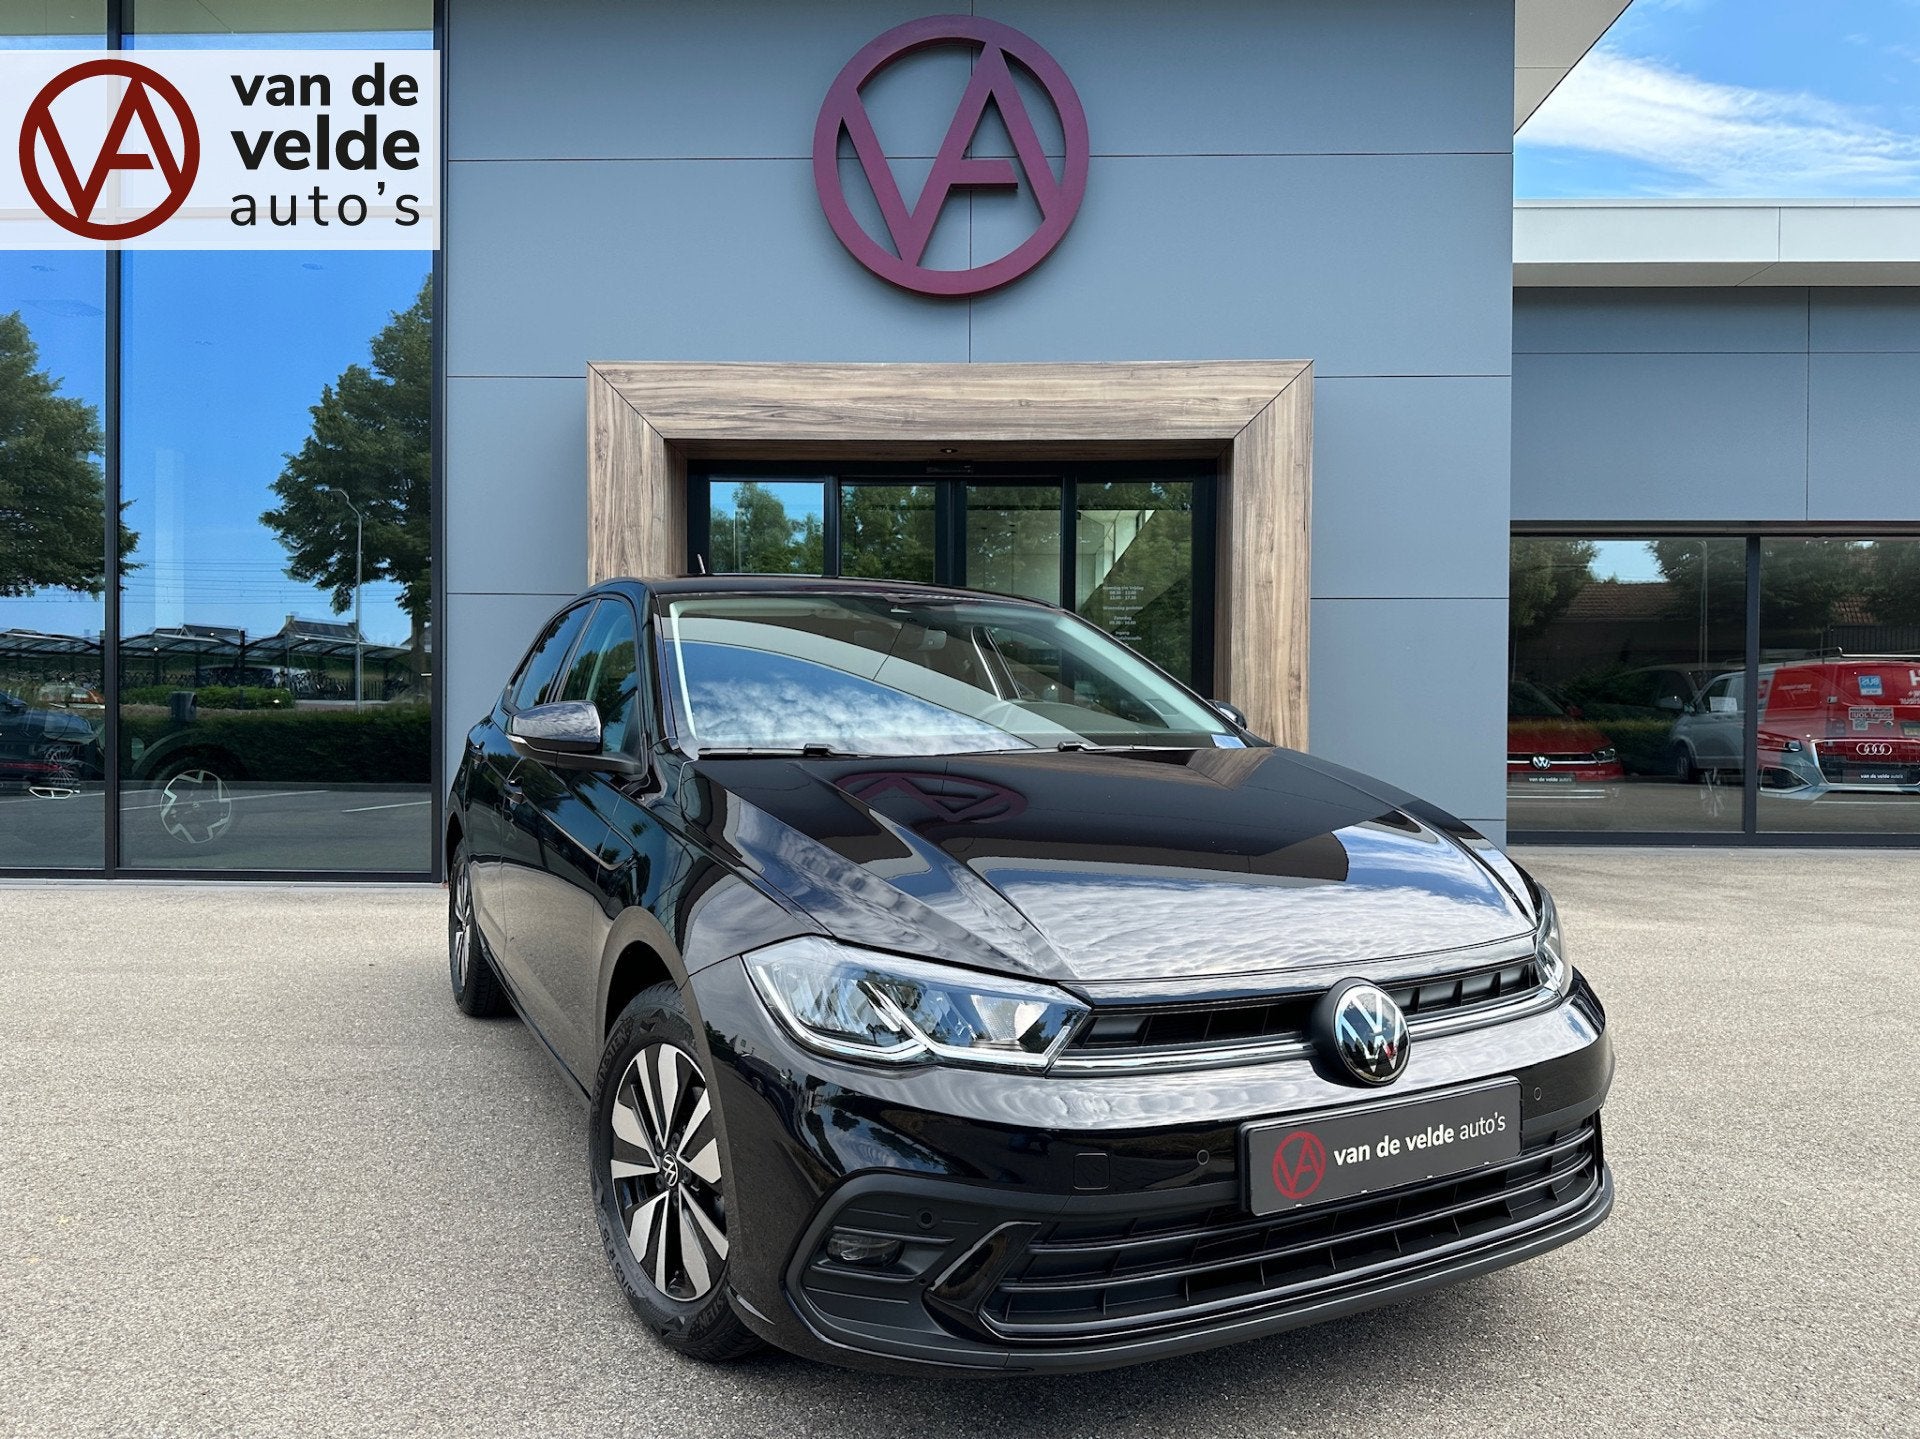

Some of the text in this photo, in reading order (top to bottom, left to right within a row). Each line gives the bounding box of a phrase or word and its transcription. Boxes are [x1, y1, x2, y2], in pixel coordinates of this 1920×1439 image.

[812, 13, 1090, 298] VA
[1334, 985, 1410, 1083] VW
[1272, 1111, 1507, 1199] VA van de velde auto's
